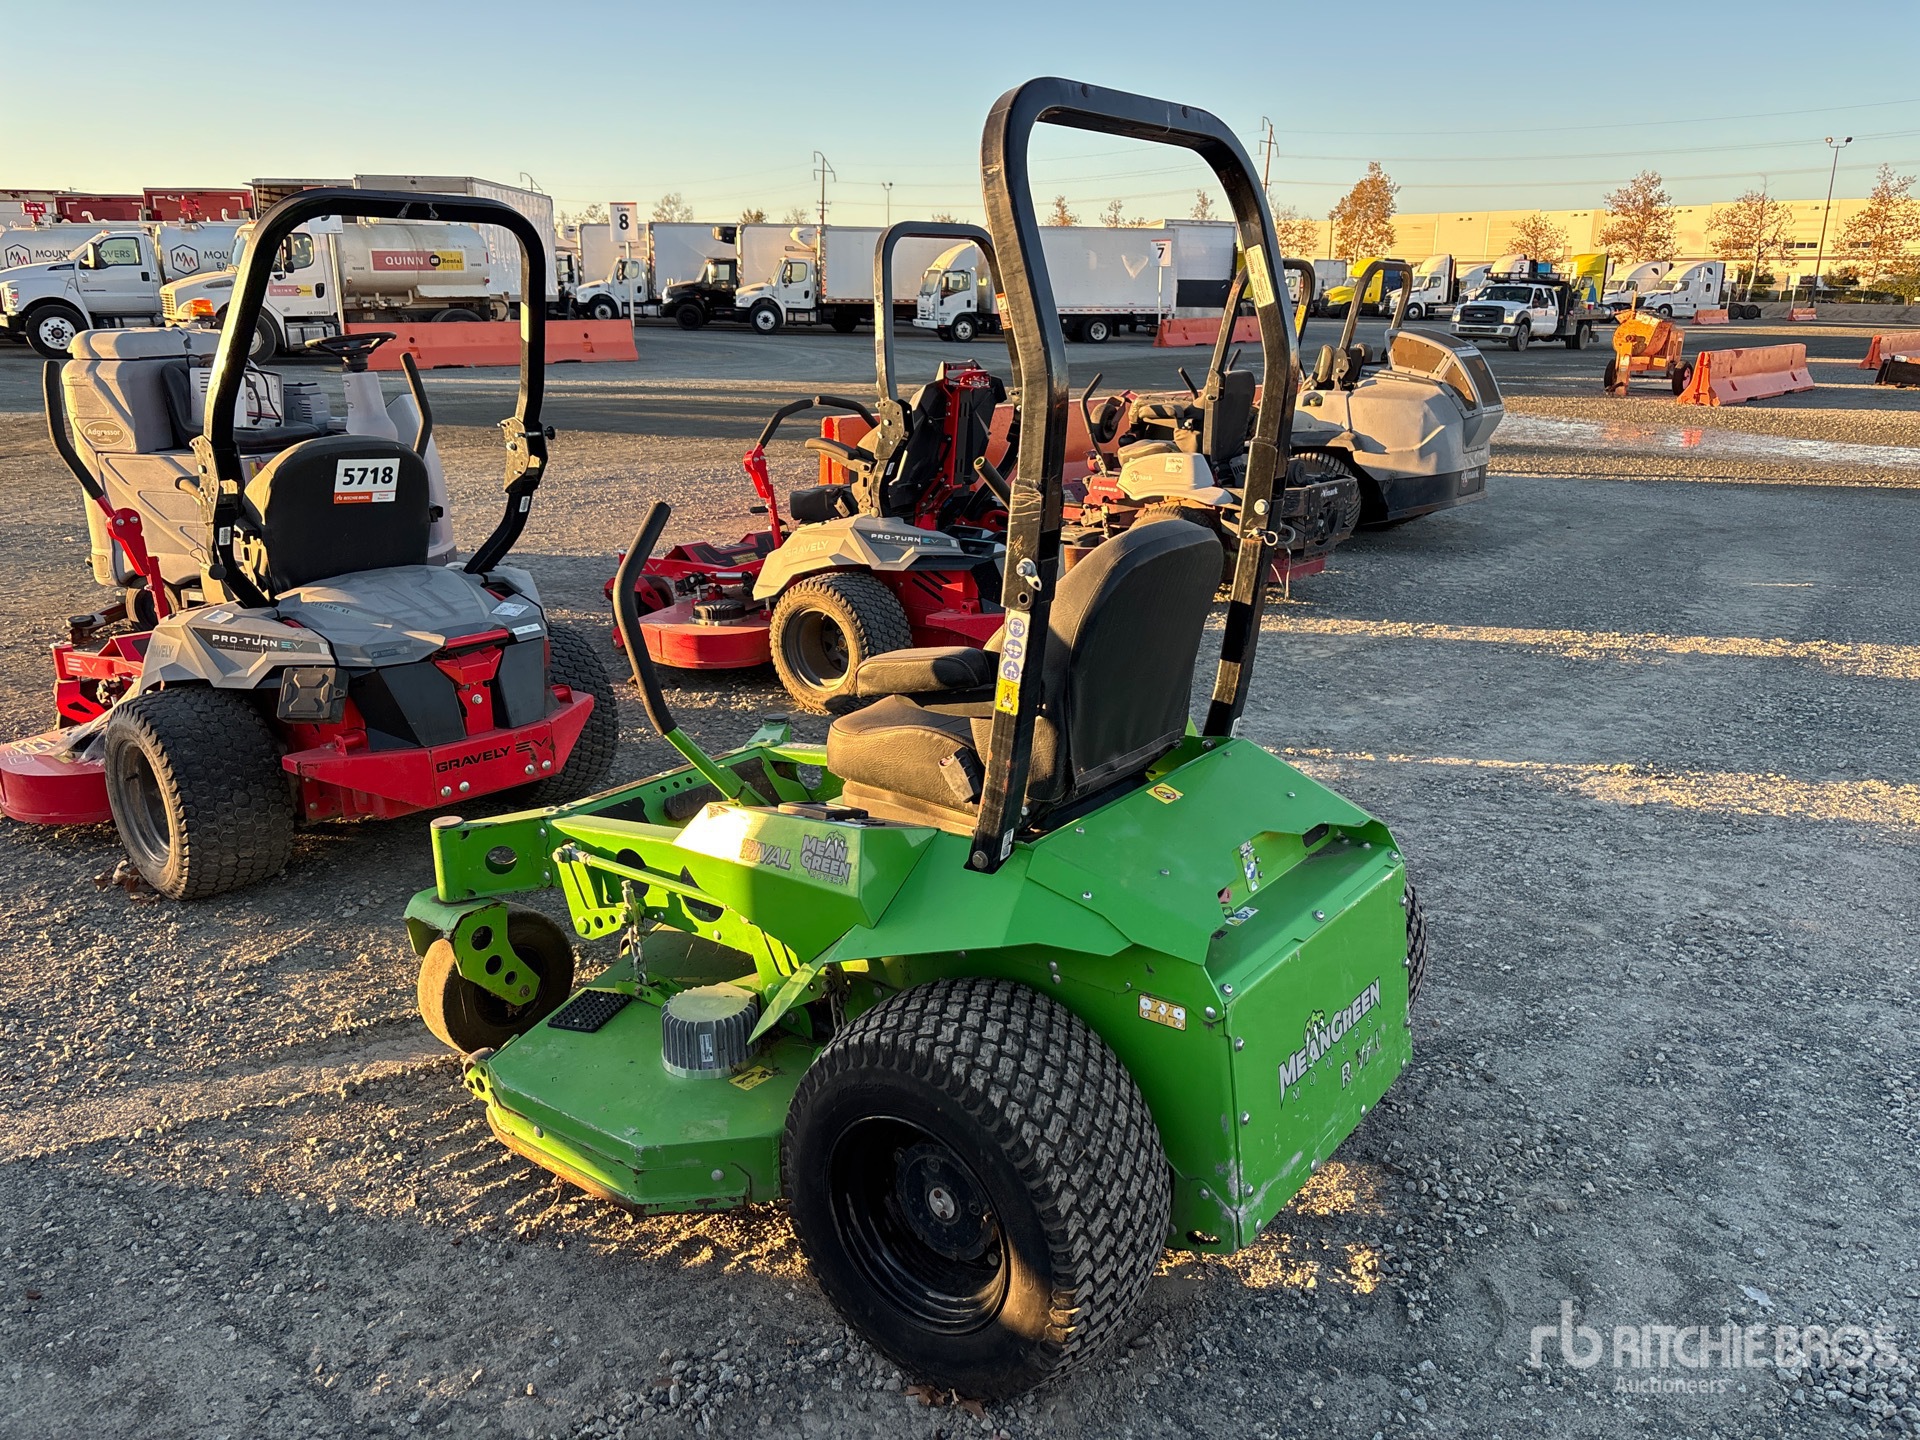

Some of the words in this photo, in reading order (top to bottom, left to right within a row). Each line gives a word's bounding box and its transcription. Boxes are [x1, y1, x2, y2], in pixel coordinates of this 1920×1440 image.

[618, 213, 630, 231] 8
[101, 249, 131, 258] OVERS
[385, 256, 424, 265] QUINN
[1157, 247, 1165, 259] 7
[1518, 264, 1525, 273] 5
[87, 428, 121, 437] Adgressor
[342, 466, 394, 486] 5718
[870, 533, 921, 543] PRO-TURN
[784, 540, 828, 558] GRAVELY
[212, 634, 278, 648] PRO-TURN
[436, 746, 511, 773] GRAVELY
[515, 736, 549, 753] EV
[740, 837, 791, 870] RIVAL
[802, 834, 848, 861] MEAN
[801, 850, 852, 886] GREEN
